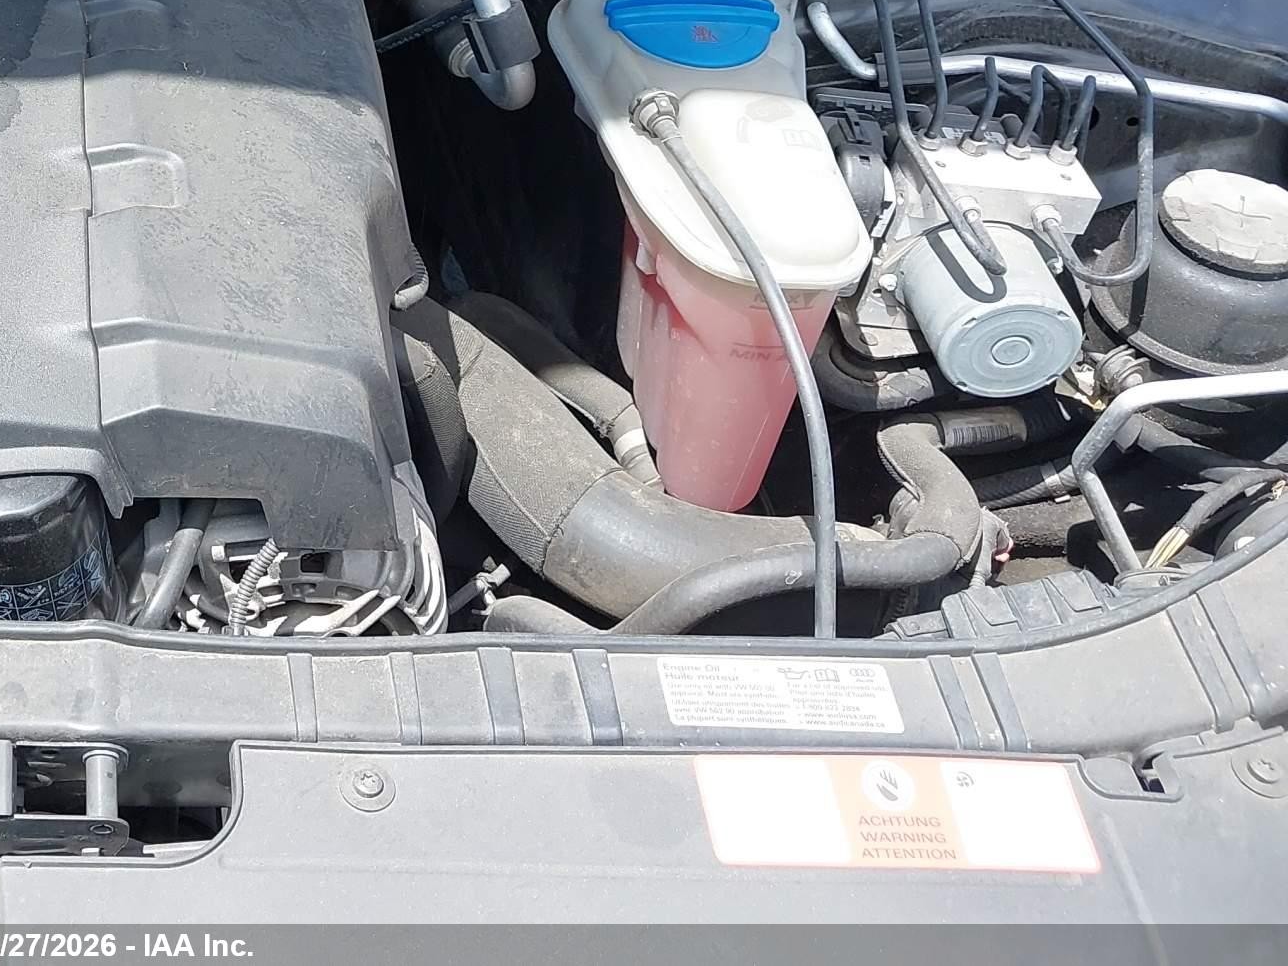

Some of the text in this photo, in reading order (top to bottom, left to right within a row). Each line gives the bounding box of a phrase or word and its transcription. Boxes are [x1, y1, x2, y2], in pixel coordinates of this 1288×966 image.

[753, 291, 801, 304] MX
[729, 348, 771, 362] MIN
[663, 664, 720, 672] Engine Oil
[858, 815, 942, 828] ACHTUNG
[860, 831, 947, 844] WARNING
[861, 847, 958, 860] ATTENTION
